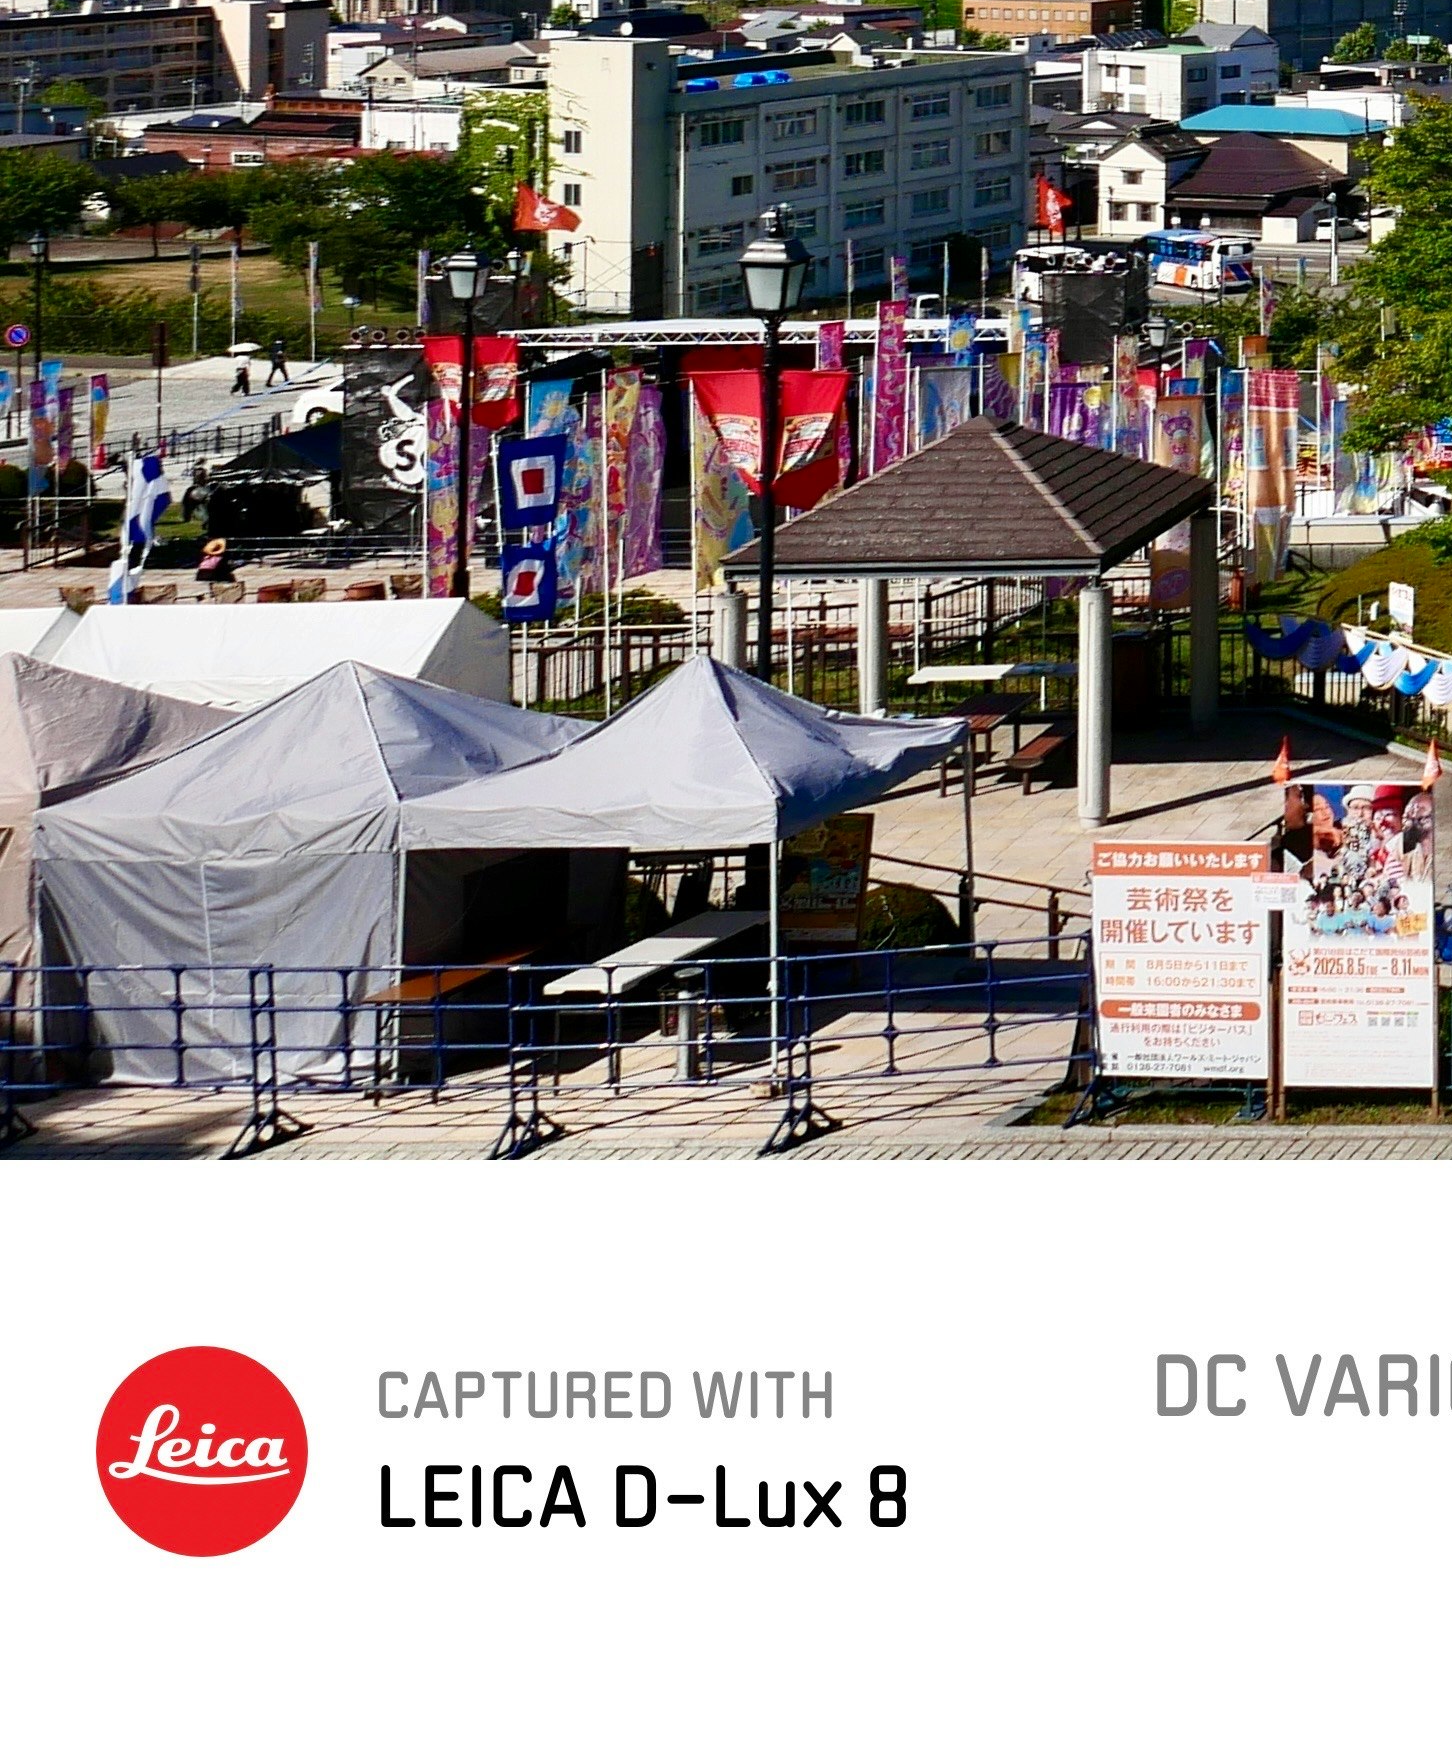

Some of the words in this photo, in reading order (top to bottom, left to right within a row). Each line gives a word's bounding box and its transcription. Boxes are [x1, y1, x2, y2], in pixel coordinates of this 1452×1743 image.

[1096, 851, 1264, 869] ご協力お願いいたします
[1126, 886, 1234, 913] 芸術祭を
[1100, 918, 1260, 945] 開催しています
[1146, 959, 1249, 971] 8月5日から11日まで
[1146, 976, 1256, 989] 16:00から21:30まで
